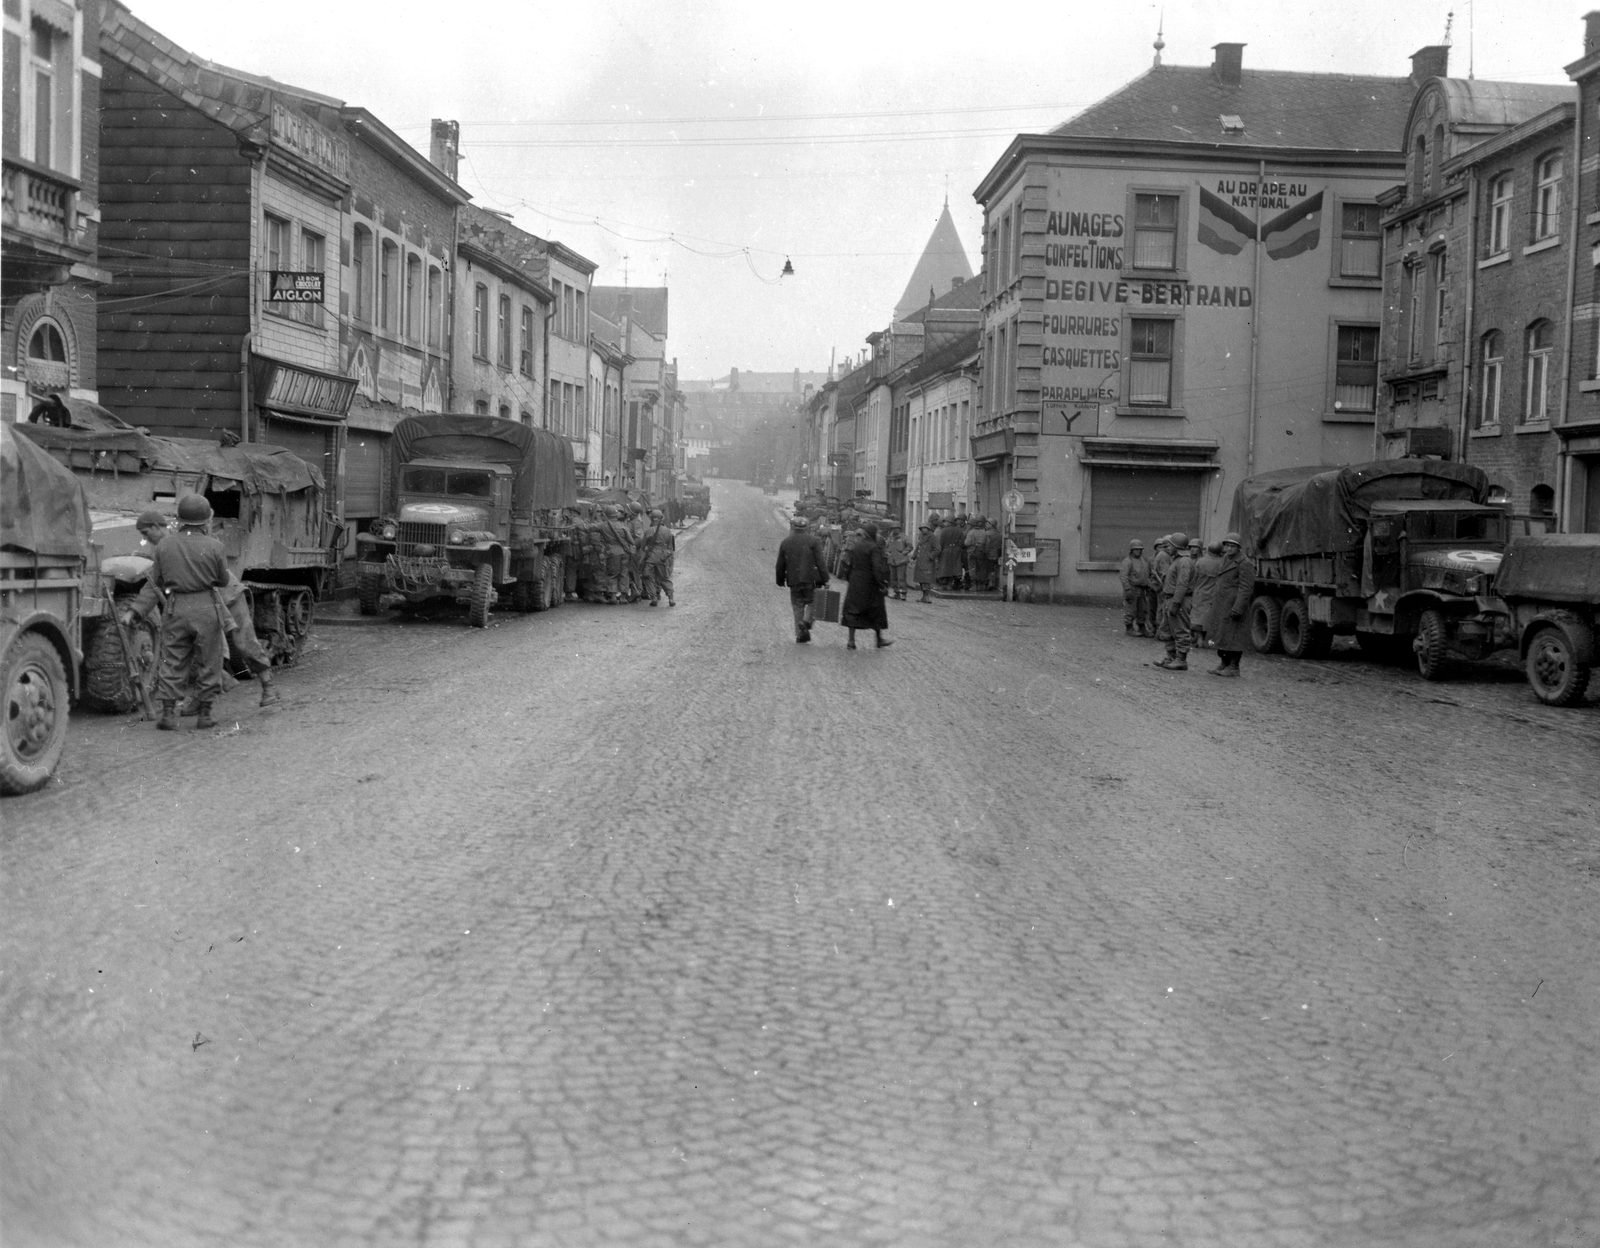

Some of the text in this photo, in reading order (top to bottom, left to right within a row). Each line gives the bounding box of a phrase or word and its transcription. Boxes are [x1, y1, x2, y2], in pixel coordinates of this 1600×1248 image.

[1217, 180, 1307, 197] AU DRAPEAU
[1232, 195, 1290, 209] NATIONAL
[1046, 211, 1124, 238] AUNAGES
[1045, 239, 1124, 270] CONFECTIONS
[272, 290, 322, 301] AIGLON
[1046, 279, 1253, 308] DEGIVE-BERTRAND
[1043, 314, 1120, 337] FOURRURES
[1042, 347, 1120, 370] CASQUETTES
